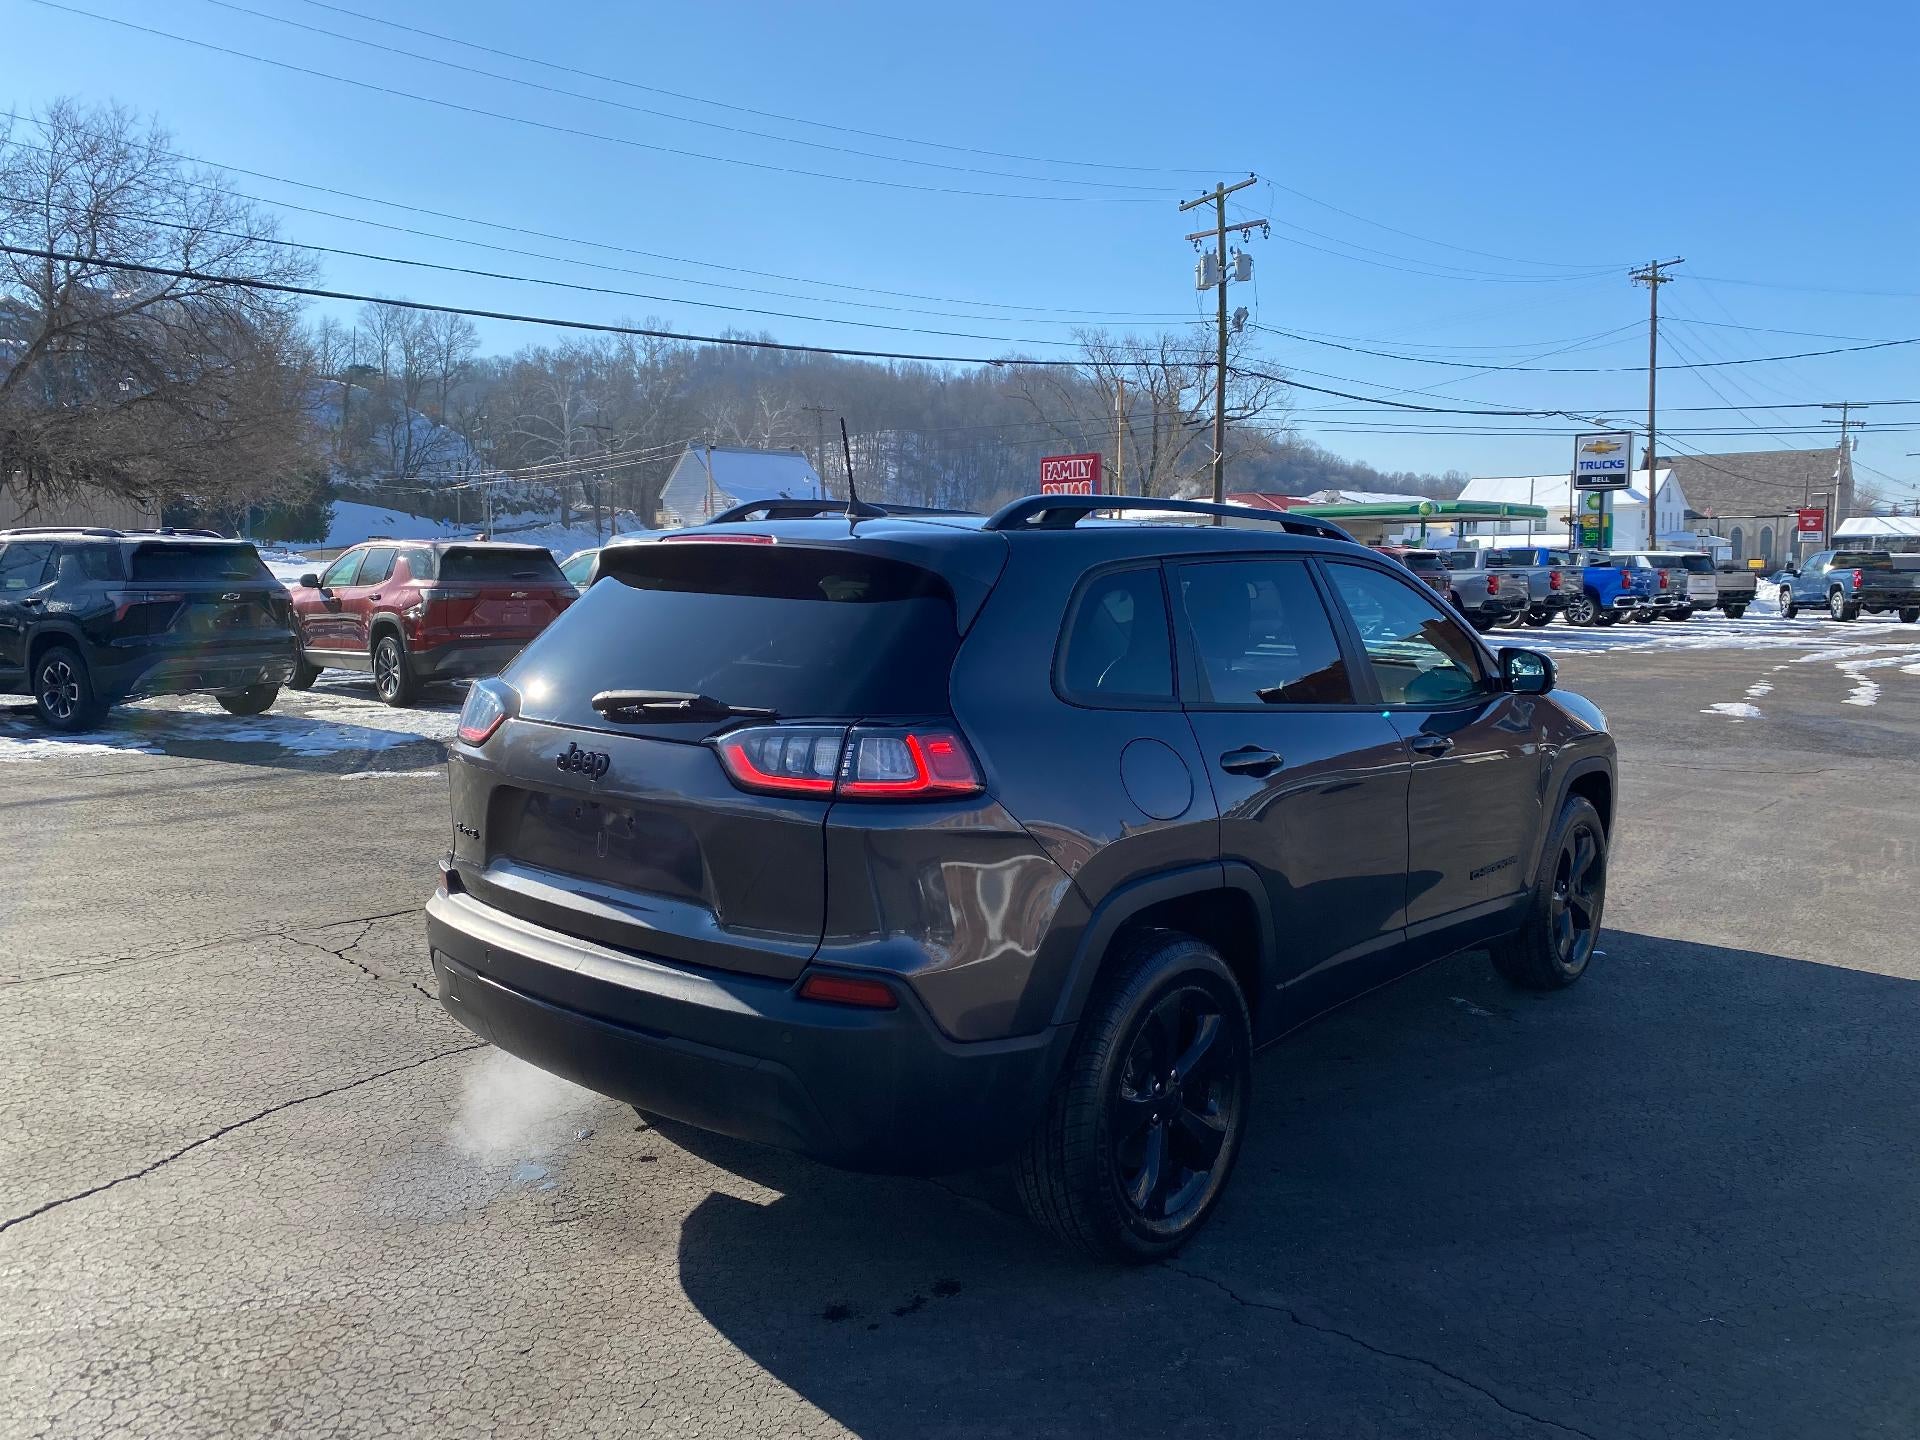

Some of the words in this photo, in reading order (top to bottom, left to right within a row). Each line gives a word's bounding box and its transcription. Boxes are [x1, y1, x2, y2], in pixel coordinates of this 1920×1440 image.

[1042, 459, 1093, 480] FAMILY
[1579, 459, 1625, 470] TRUCKS
[556, 742, 611, 782] Jeep
